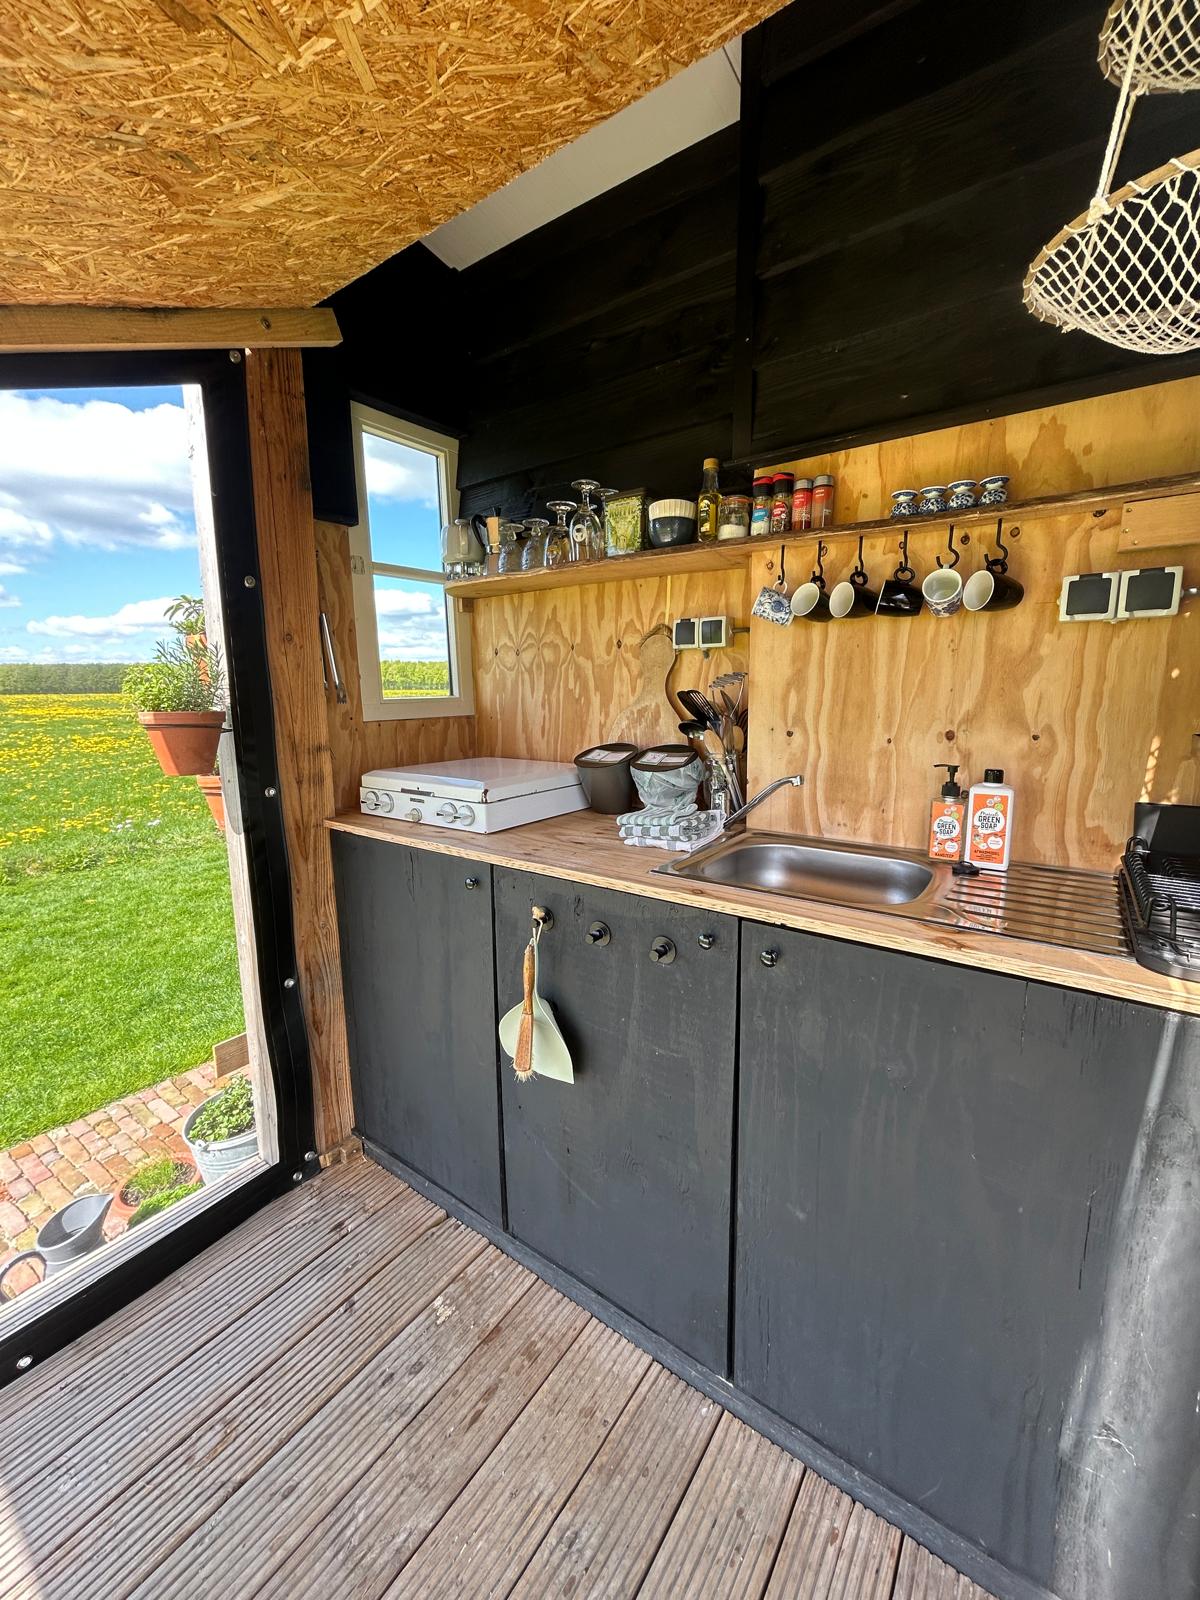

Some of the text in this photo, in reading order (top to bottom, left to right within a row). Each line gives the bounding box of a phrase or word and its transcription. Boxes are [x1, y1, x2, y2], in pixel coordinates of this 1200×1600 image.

[978, 815, 1001, 824] GREEN
[937, 822, 956, 830] GREEN
[980, 822, 998, 830] SOAP
